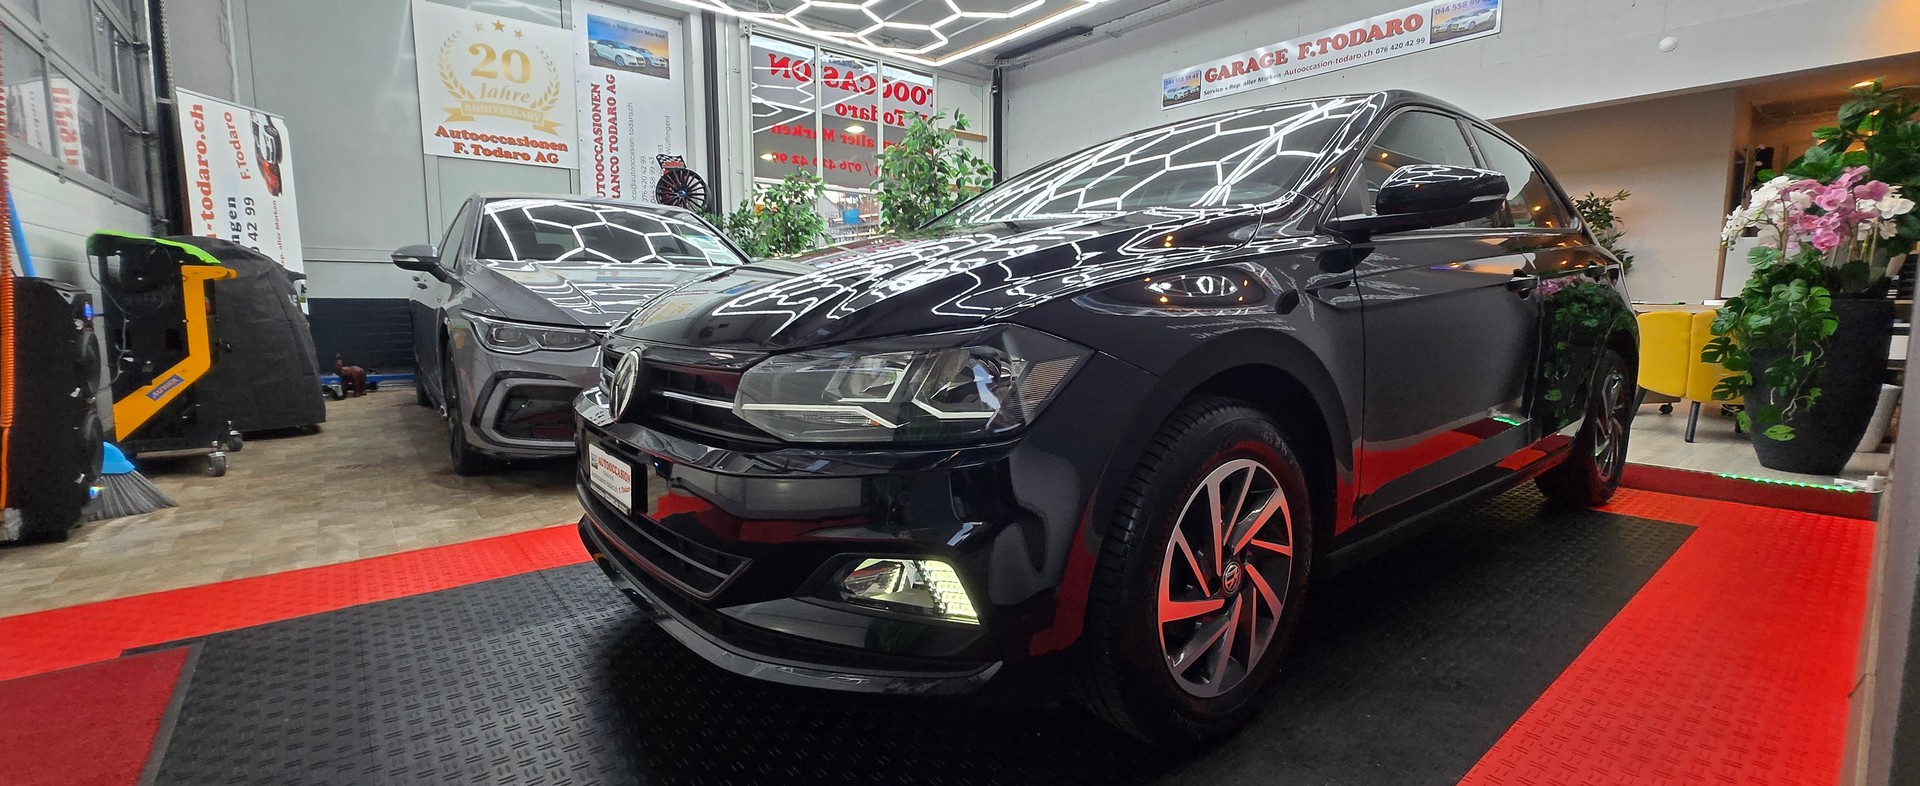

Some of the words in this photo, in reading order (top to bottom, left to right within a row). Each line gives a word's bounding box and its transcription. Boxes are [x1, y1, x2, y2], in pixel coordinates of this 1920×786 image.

[1435, 6, 1450, 15] 044
[1452, 1, 1467, 10] 558
[644, 30, 666, 40] Marken
[468, 43, 532, 84] 20
[1203, 86, 1224, 96] Service
[1242, 78, 1257, 88] aller
[1257, 73, 1282, 83] Marken
[1283, 49, 1373, 76] Autooccasion-todaro.ch
[1375, 46, 1389, 55] 076
[1390, 42, 1404, 52] 420
[1404, 39, 1416, 48] 42
[1416, 37, 1426, 46] 99
[1204, 48, 1289, 83] GARAGE
[479, 82, 531, 103] Jahre
[606, 74, 616, 95] AG
[463, 103, 543, 122] ANNIVERSARY
[607, 96, 619, 154] TODARO
[434, 125, 569, 152] Autooccasionen
[452, 141, 470, 155] F.
[470, 144, 532, 162] Todaro
[534, 152, 560, 165] AG
[243, 196, 255, 216] 99
[272, 200, 281, 230] Marken
[247, 222, 259, 242] 42
